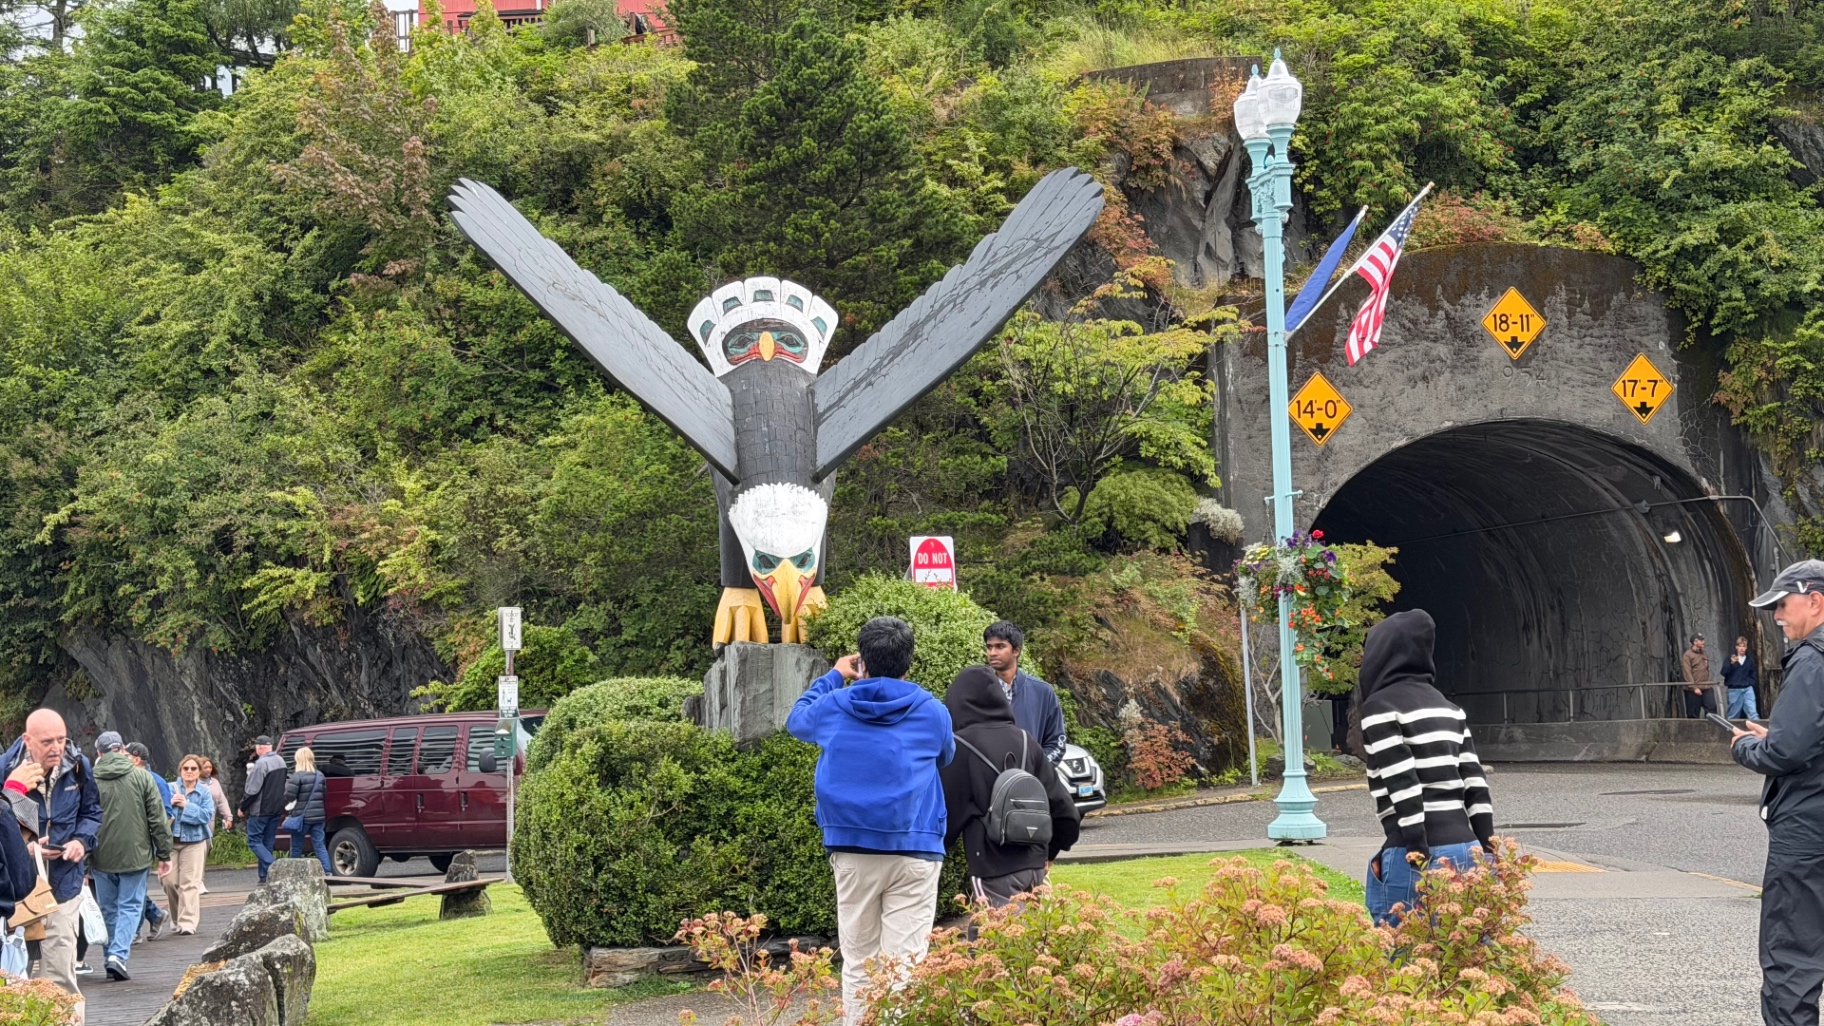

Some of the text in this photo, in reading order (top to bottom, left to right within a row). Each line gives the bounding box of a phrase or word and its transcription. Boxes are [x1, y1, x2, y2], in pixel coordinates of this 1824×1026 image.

[1492, 313, 1535, 332] 18'-11"
[1621, 379, 1663, 398] 17'-7"
[1296, 399, 1341, 419] 14'-0"
[917, 552, 948, 565] DO NOT
